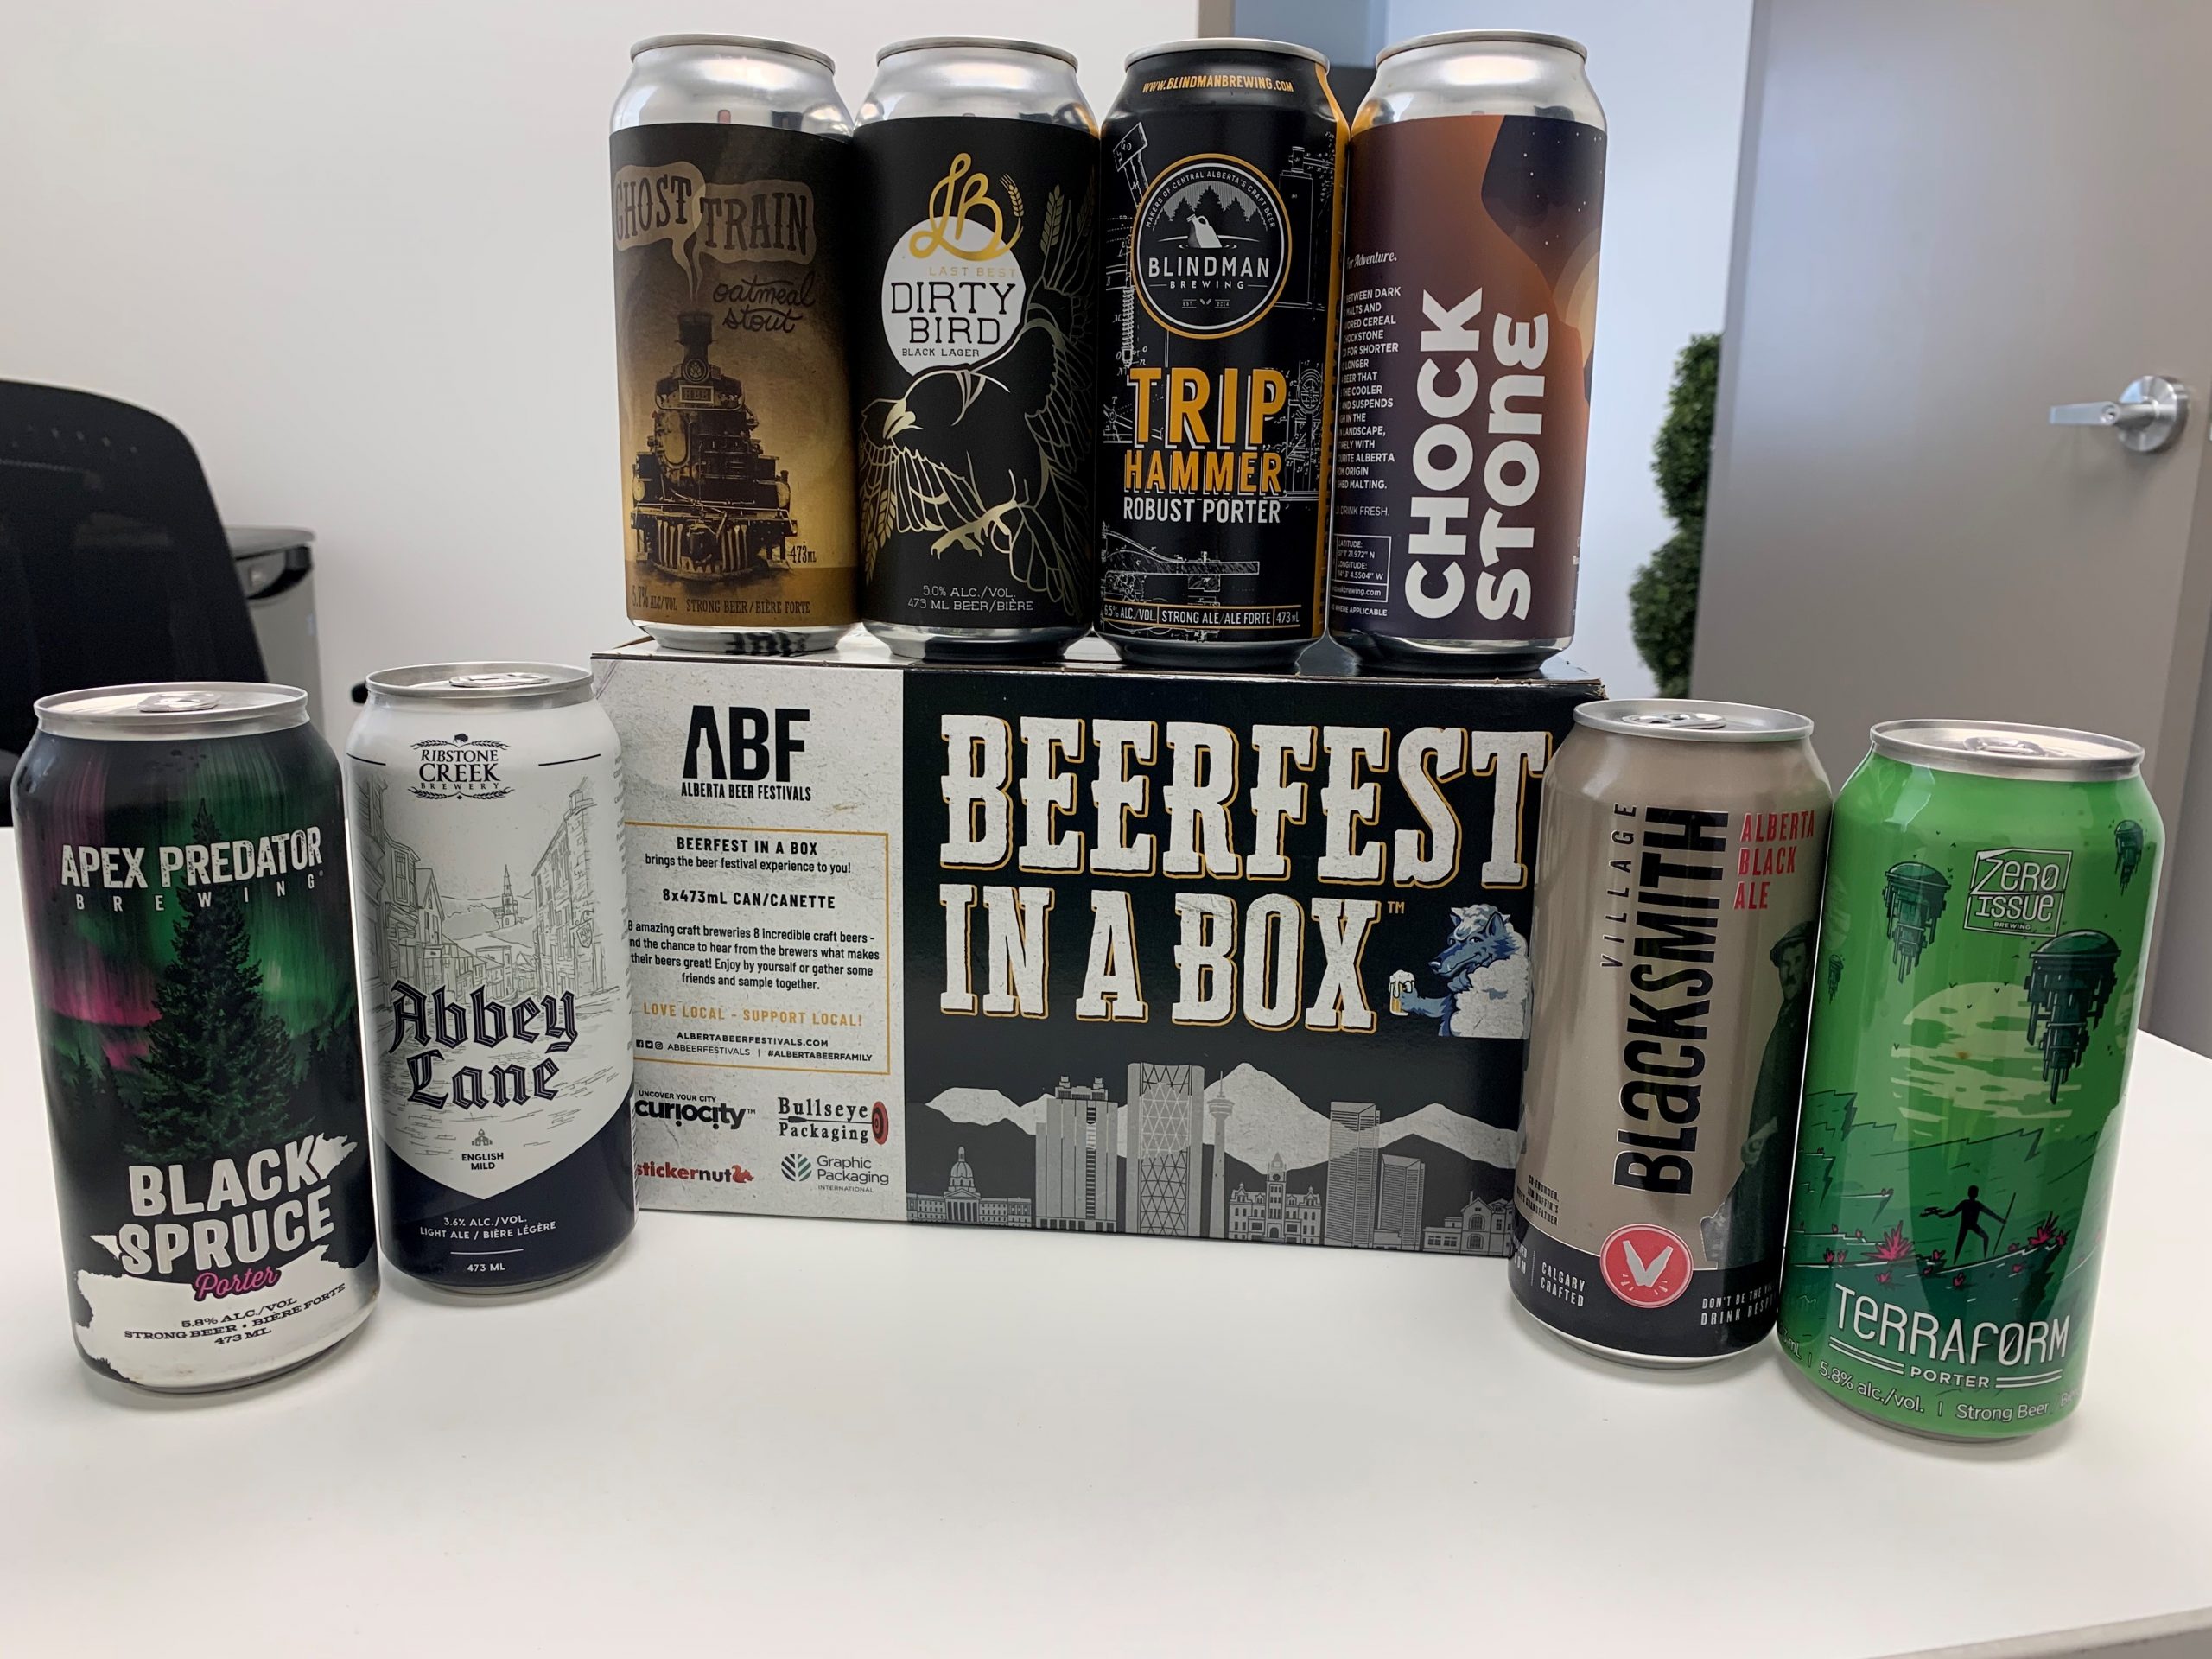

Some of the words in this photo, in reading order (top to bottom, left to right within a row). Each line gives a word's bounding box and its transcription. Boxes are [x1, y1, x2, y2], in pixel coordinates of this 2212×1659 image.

[1142, 75, 1294, 92] WWW.BLINDMANBREWING.COM
[1146, 198, 1163, 227] MAKERS
[1172, 171, 1204, 189] CENTRAL
[1207, 171, 1247, 187] ALBERTA'S
[1247, 185, 1267, 206] CRAFT
[1264, 206, 1275, 228] BEER
[616, 175, 692, 241] GHOST
[700, 192, 808, 257] TRAIN
[1148, 257, 1269, 277] BLINDMAN
[1354, 251, 1396, 267] Adventure.
[929, 266, 968, 277] LAST
[976, 267, 1016, 277] BEST
[713, 275, 815, 314] oatmeal
[1170, 281, 1244, 289] BREWING
[1375, 287, 1401, 298] DARK
[891, 282, 1016, 315] DIRTY
[722, 309, 804, 334] stout
[1363, 315, 1396, 327] CEREAL
[910, 318, 1001, 345] BIRD
[902, 346, 937, 358] BLACK
[940, 347, 980, 358] LAGER
[1359, 343, 1398, 354] SHORTER
[1345, 359, 1369, 369] LONGER
[1357, 372, 1377, 381] THAT
[1352, 385, 1382, 395] COOLER
[1127, 367, 1287, 449] TRIP
[1352, 398, 1394, 409] SUSPENDS
[1343, 426, 1385, 437] LANDSCAPE,
[1355, 440, 1375, 449] WITH
[1404, 287, 1483, 619] CHOCK
[1356, 453, 1395, 462] ALBERTA
[1124, 450, 1282, 495] HAMMER
[1345, 467, 1369, 475] ORIGIN
[1350, 480, 1387, 489] MALTING.
[1124, 499, 1195, 522] ROBUST
[1203, 499, 1281, 524] PORTER
[1359, 506, 1389, 516] FRESH.
[923, 585, 946, 596] 5.0%
[950, 586, 1015, 599] ALC./VOL.
[651, 595, 677, 610] ALC/VOL
[686, 599, 721, 613] STRONG
[785, 601, 810, 613] FORTE
[908, 598, 926, 608] 473
[931, 601, 950, 609] ML
[954, 599, 1033, 613] BEER/BIÈRE
[1350, 607, 1387, 616] APPLICABLE
[1120, 607, 1156, 621] ALC./VOL.
[1161, 611, 1199, 624] STRONG
[1202, 612, 1242, 624] ALE/ALE
[1243, 612, 1270, 624] FORTE
[682, 705, 810, 783] ABF
[421, 749, 499, 762] RIBSTONE
[419, 763, 501, 782] CREEK
[681, 782, 726, 798] ALBERTA
[728, 784, 754, 799] BEER
[758, 785, 811, 801] FESTIVALS
[940, 714, 1554, 889] BEERFEST
[1739, 810, 1815, 843] ALBERTA
[677, 836, 748, 853] BEERFEST
[754, 840, 769, 854] IN
[775, 842, 785, 854] A
[791, 842, 817, 855] BOX
[61, 844, 149, 889] APEX
[159, 826, 323, 887] PREDATOR
[645, 854, 675, 868] brings
[696, 857, 717, 868] beer
[721, 858, 757, 869] festival
[760, 861, 814, 873] experience
[830, 862, 850, 874] you!
[1737, 846, 1797, 876] BLACK
[76, 874, 315, 912] BREWING
[1600, 802, 1637, 969] VILLAGE
[663, 888, 728, 905] 8x473mL
[733, 893, 836, 909] CAN/CANETTE
[1732, 881, 1770, 910] ALE
[636, 923, 674, 937] amazing
[677, 925, 700, 935] craft
[703, 925, 751, 938] breweries
[762, 928, 810, 941] incredible
[813, 931, 837, 942] craft
[840, 931, 868, 943] beers
[1993, 921, 2031, 931] BREWING
[661, 939, 695, 951] chance
[779, 945, 817, 957] brewers
[848, 949, 880, 960] makes
[940, 883, 1054, 1019] IN
[1075, 889, 1148, 1023] A
[1172, 893, 1383, 1033] BOX
[655, 954, 681, 966] beers
[683, 958, 712, 969] great!
[715, 958, 741, 972] Enjoy
[758, 962, 797, 973] yourself
[812, 963, 843, 976] gather
[682, 973, 715, 985] friends
[739, 977, 772, 989] sample
[776, 978, 819, 991] together.
[388, 979, 579, 1054] Abbey
[644, 1002, 676, 1016] LOVE
[683, 1005, 725, 1020] LOCAL
[743, 1009, 806, 1024] SUPPORT
[812, 1013, 862, 1027] LOCAL!
[677, 1032, 829, 1047] ALBERTABEERFESTIVALS.COM
[667, 1043, 750, 1056] ABBEERFESTIVALS
[767, 1049, 873, 1062] #ALBERTABEERFAMILY
[406, 1049, 560, 1109] Lane
[639, 1090, 674, 1100] UNCOVER
[634, 1099, 748, 1130] curiocity
[778, 1097, 868, 1122] Bullseye
[779, 1122, 869, 1144] Packaging
[461, 1153, 504, 1161] ENGLISH
[471, 1162, 495, 1171] MILD
[817, 1154, 872, 1170] Graphic
[129, 1135, 318, 1217] BLACK
[636, 1162, 732, 1183] stickernut
[817, 1169, 889, 1185] Packaging
[817, 1185, 874, 1193] INTERNATIONAL
[118, 1185, 334, 1274] SPRUCE
[420, 1226, 447, 1238] LIGHT
[483, 1229, 513, 1238] BIÈRE
[517, 1221, 556, 1236] LÉGÈRE
[444, 1217, 466, 1226] 3.6%
[470, 1215, 527, 1227] ALC./VOL.
[194, 1266, 278, 1300] Porter
[1541, 1262, 1585, 1292] CALGARY
[1541, 1277, 1584, 1306] CRAFTED
[1702, 1296, 1732, 1309] DON'T
[1736, 1293, 1745, 1305] BE
[124, 1330, 188, 1340] STRONG
[189, 1324, 238, 1338] BEER
[251, 1305, 302, 1327] BIÈRE
[303, 1283, 346, 1310] FORTE
[181, 1317, 219, 1328] 5.8%
[221, 1297, 297, 1323] ALC./VOL
[1700, 1308, 1740, 1325] DRINK
[214, 1333, 242, 1345] 473
[245, 1327, 271, 1339] ML
[1910, 1366, 1990, 1389] PORTER
[1819, 1361, 1854, 1391] 5.8%
[1857, 1381, 1925, 1413] alc./vol.
[1956, 1404, 2012, 1422] Strong
[2018, 1401, 2050, 1419] Beer
